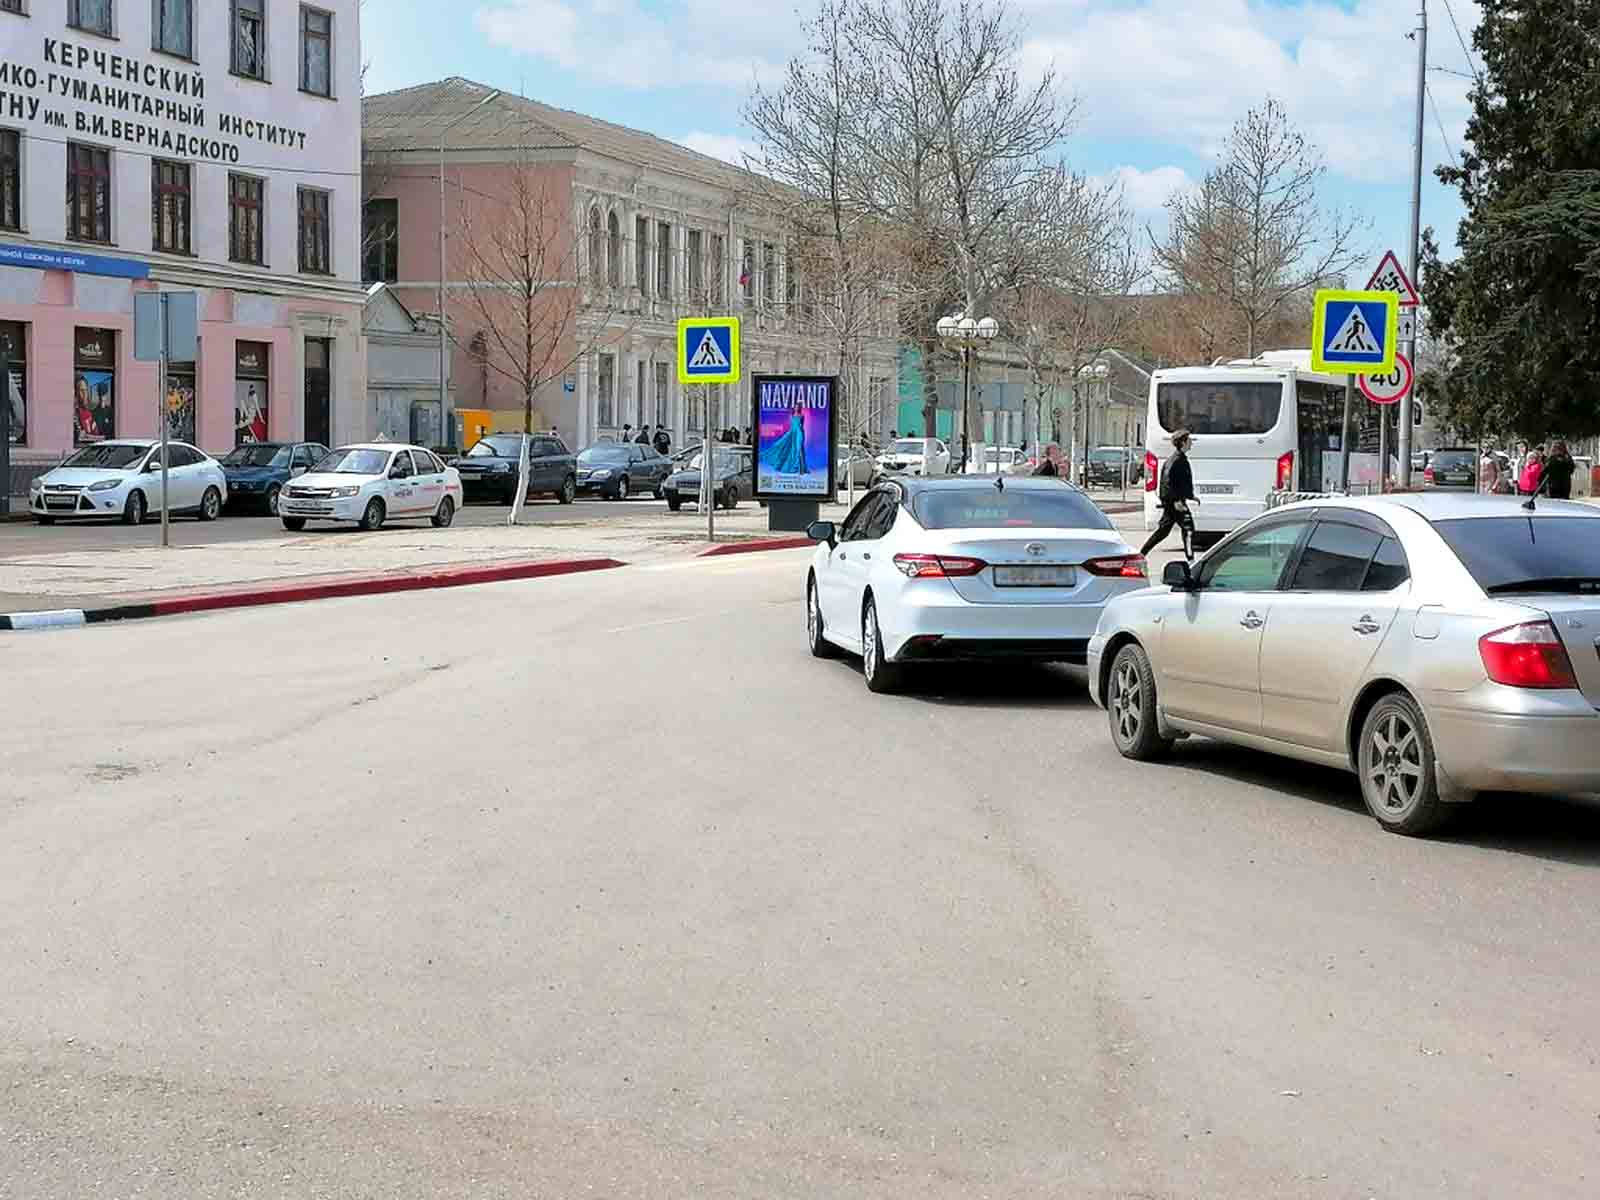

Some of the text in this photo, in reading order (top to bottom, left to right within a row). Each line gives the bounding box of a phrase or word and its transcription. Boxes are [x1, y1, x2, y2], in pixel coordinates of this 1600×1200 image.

[44, 38, 205, 99] КЕРЧЕНСКИЙ
[219, 113, 307, 150] ИНСТИТУТ
[1370, 366, 1401, 386] 40
[762, 384, 827, 409] NAVIANO
